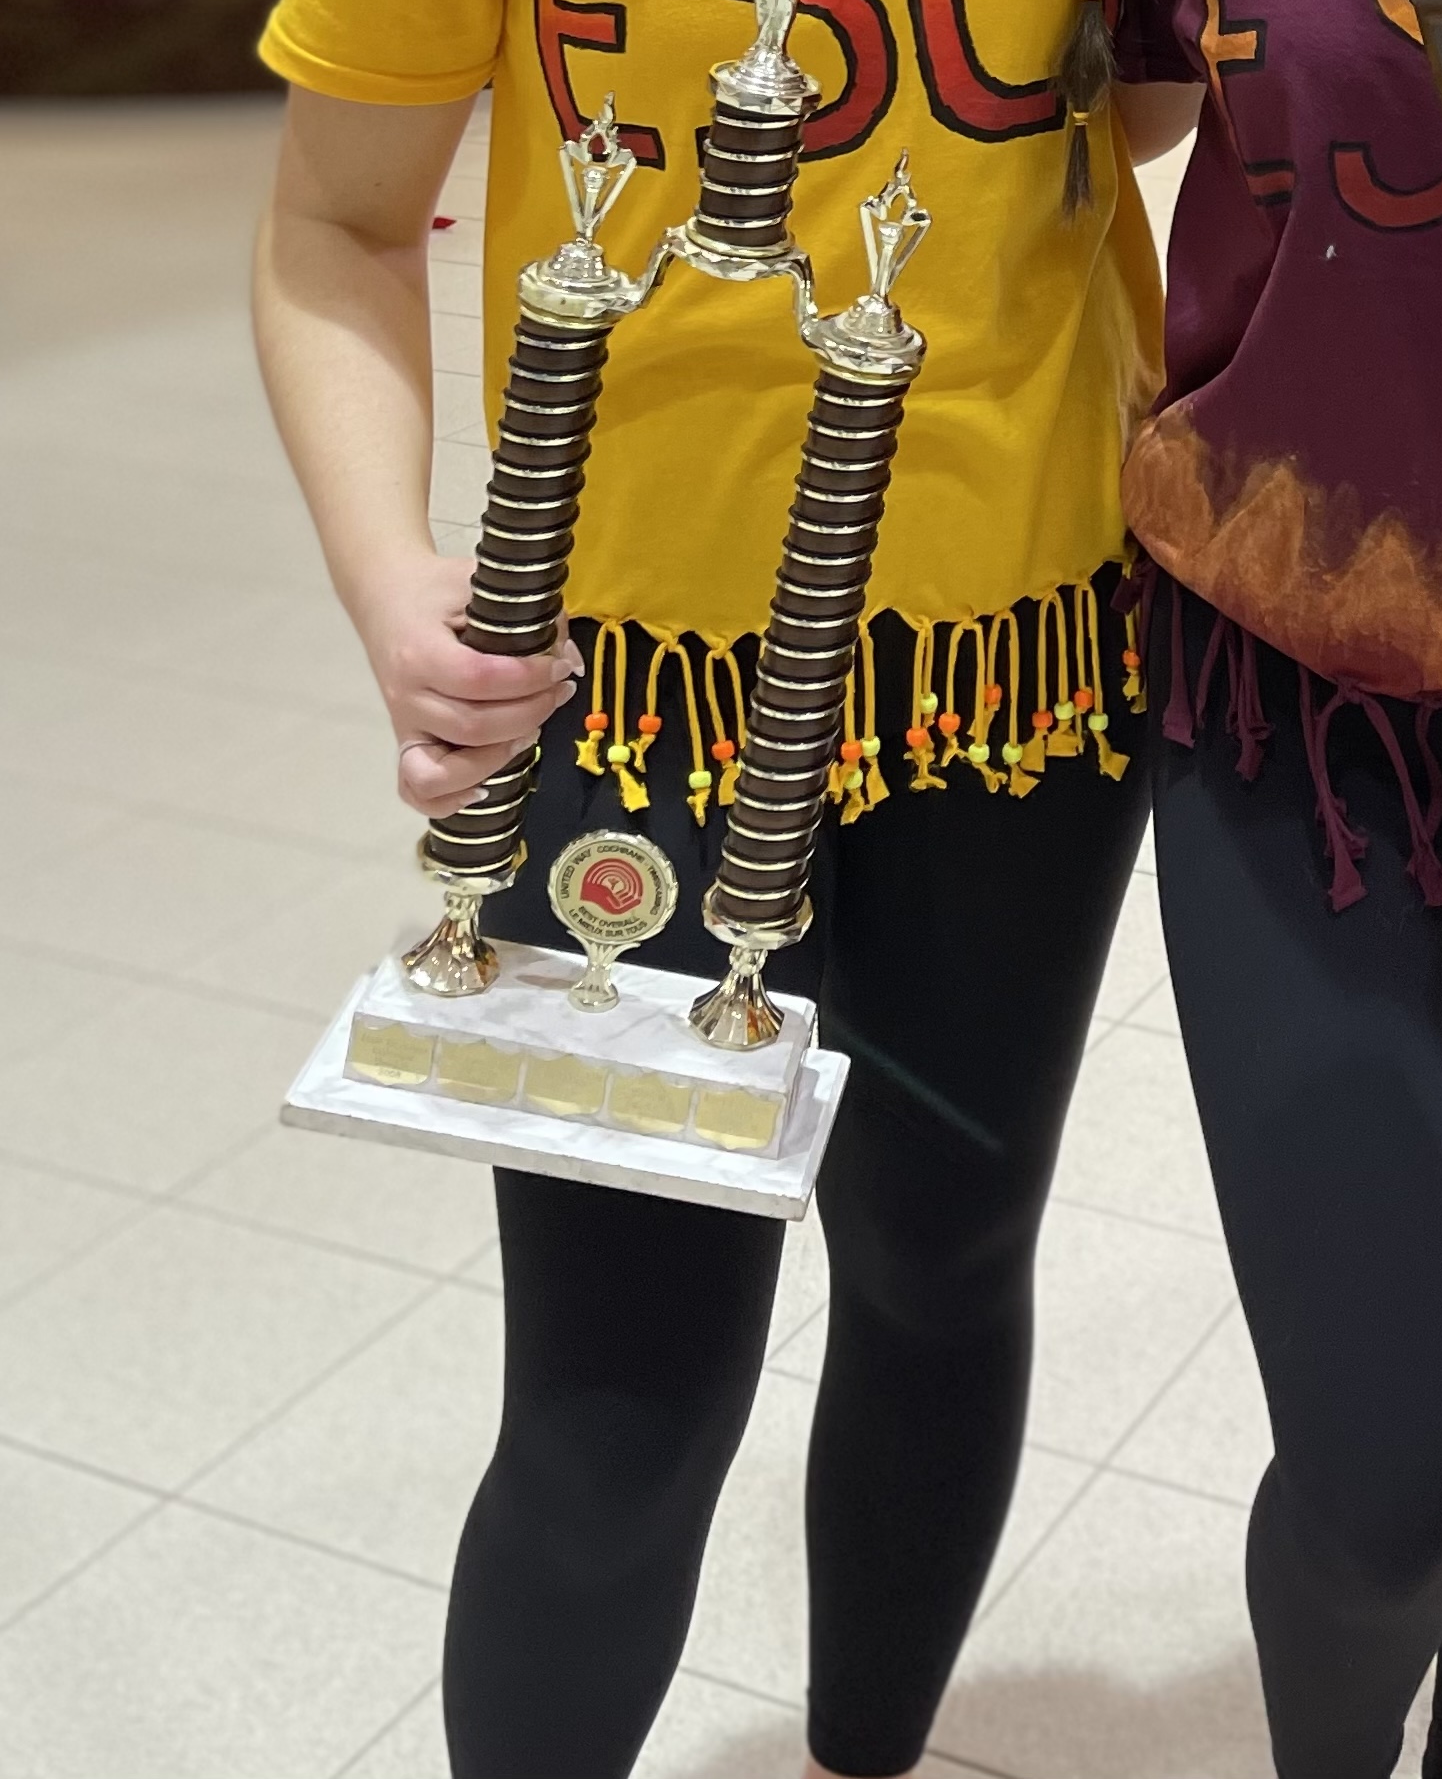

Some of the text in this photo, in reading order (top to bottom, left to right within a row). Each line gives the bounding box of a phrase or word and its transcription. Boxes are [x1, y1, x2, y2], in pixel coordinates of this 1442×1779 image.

[561, 865, 575, 899] UNITED
[572, 847, 592, 865] WAY
[568, 908, 579, 919] LE
[578, 918, 602, 936] MIEUX
[626, 920, 648, 936] TOUS
[578, 906, 641, 929] BEST OVERALL
